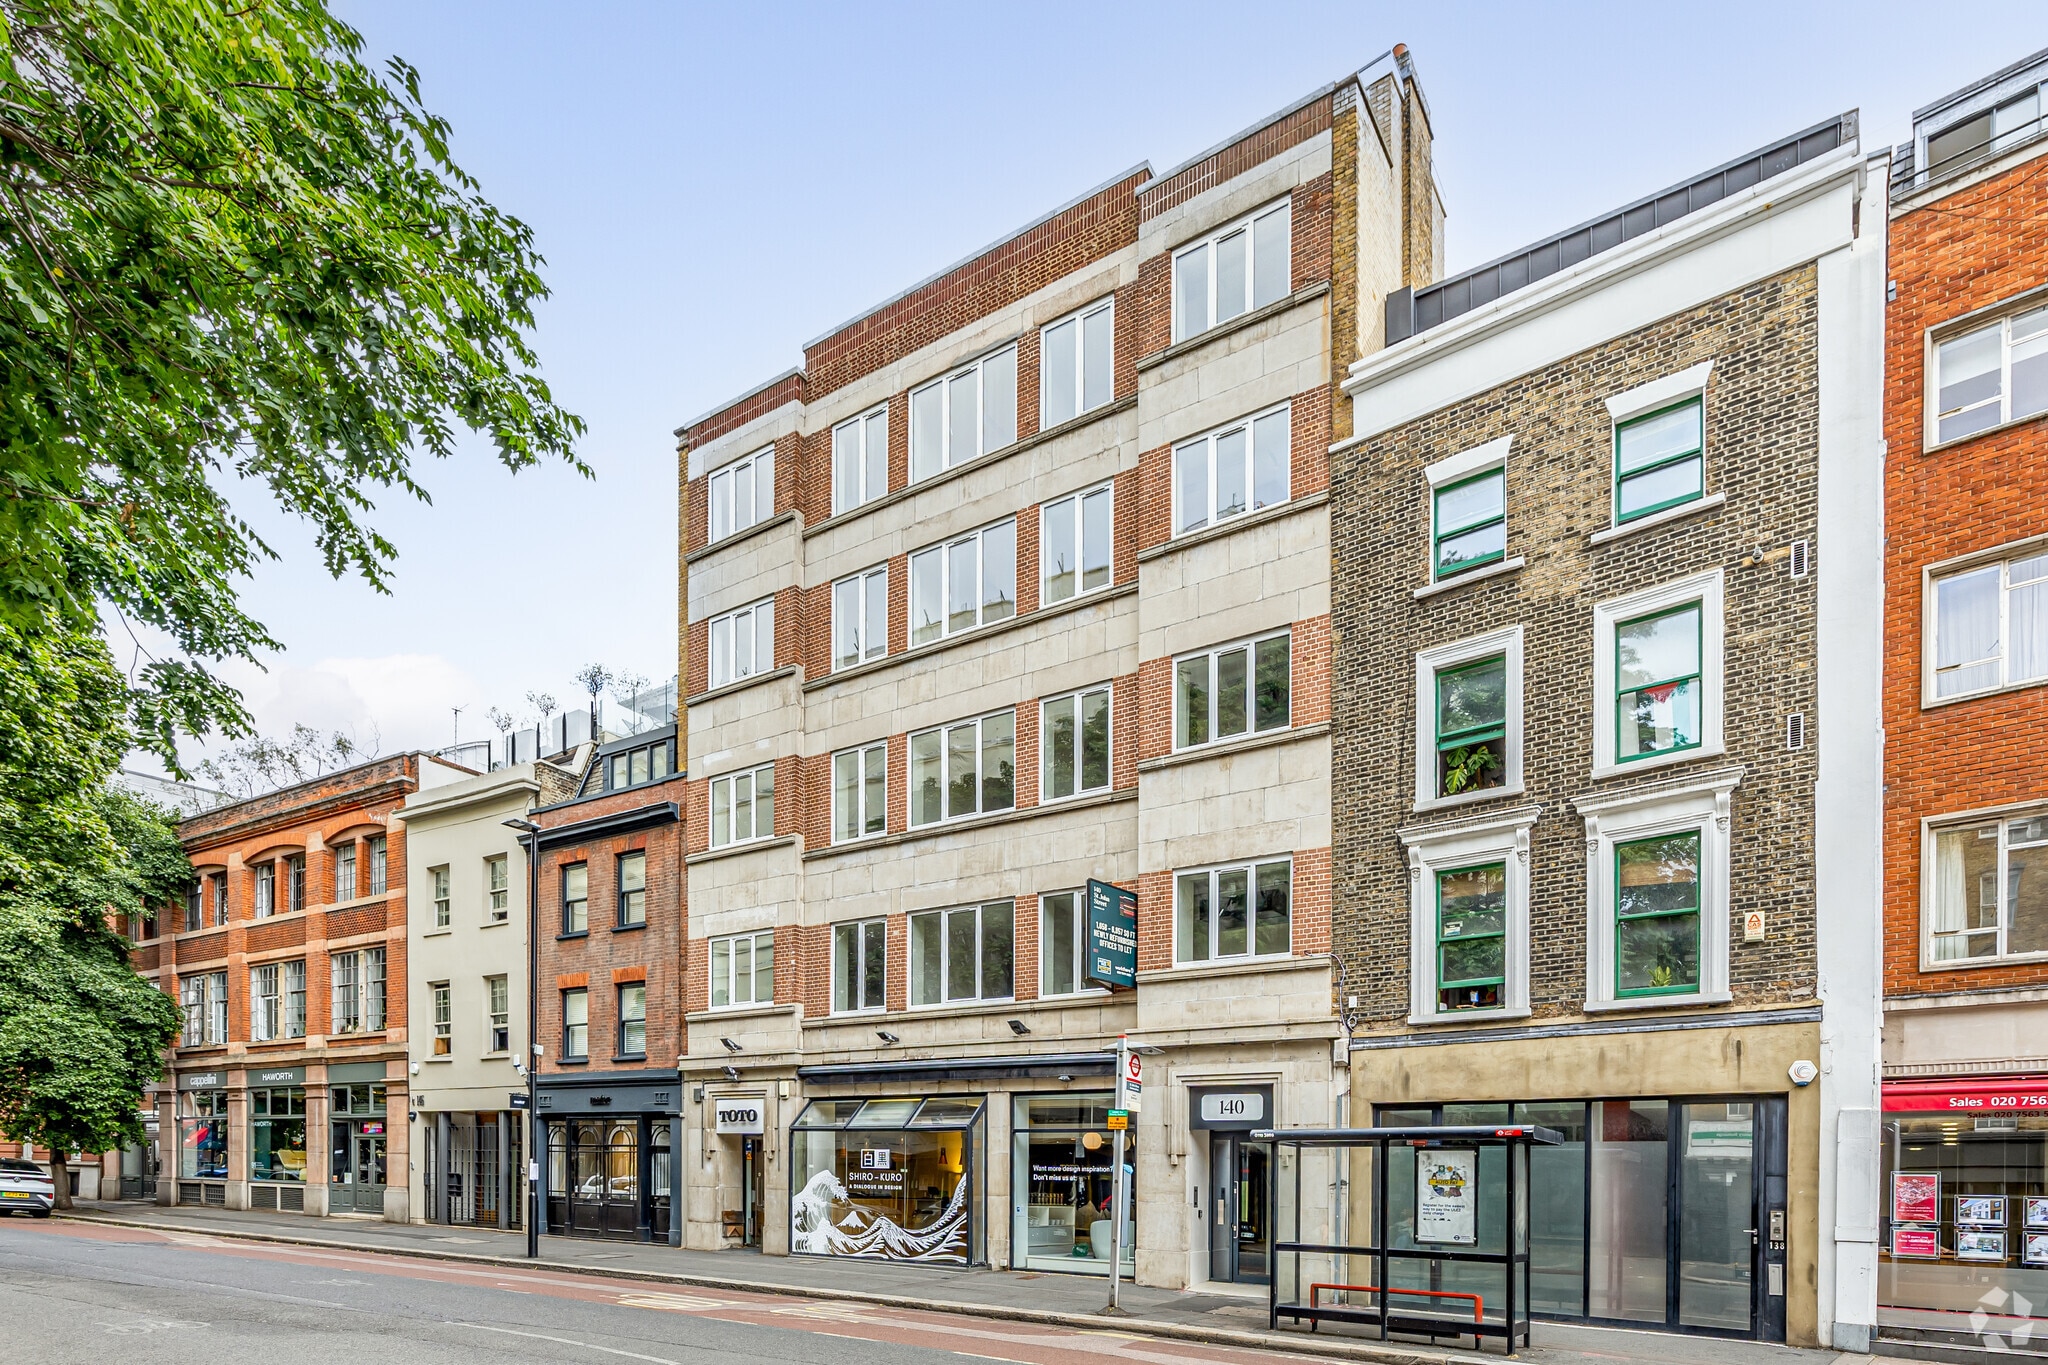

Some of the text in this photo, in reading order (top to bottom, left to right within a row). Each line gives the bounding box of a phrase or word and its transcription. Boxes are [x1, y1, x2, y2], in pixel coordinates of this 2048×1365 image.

[1094, 929, 1109, 939] NEWLY
[1099, 939, 1133, 954] OFFICES TO LET
[190, 1073, 217, 1087] cappellini
[262, 1072, 293, 1081] HAWORTH
[1949, 1095, 2048, 1107] Sales 020 756
[1219, 1099, 1245, 1115] 140
[718, 1109, 758, 1123] TOTO
[1967, 1111, 1992, 1119] Sales
[2015, 1110, 2040, 1118] 7563
[1033, 1164, 1047, 1172] Want
[1062, 1165, 1080, 1173] design
[1081, 1165, 1113, 1173] inspiration?
[849, 1172, 873, 1180] SHIRO
[880, 1173, 902, 1181] KURO
[1769, 1241, 1785, 1250] 138
